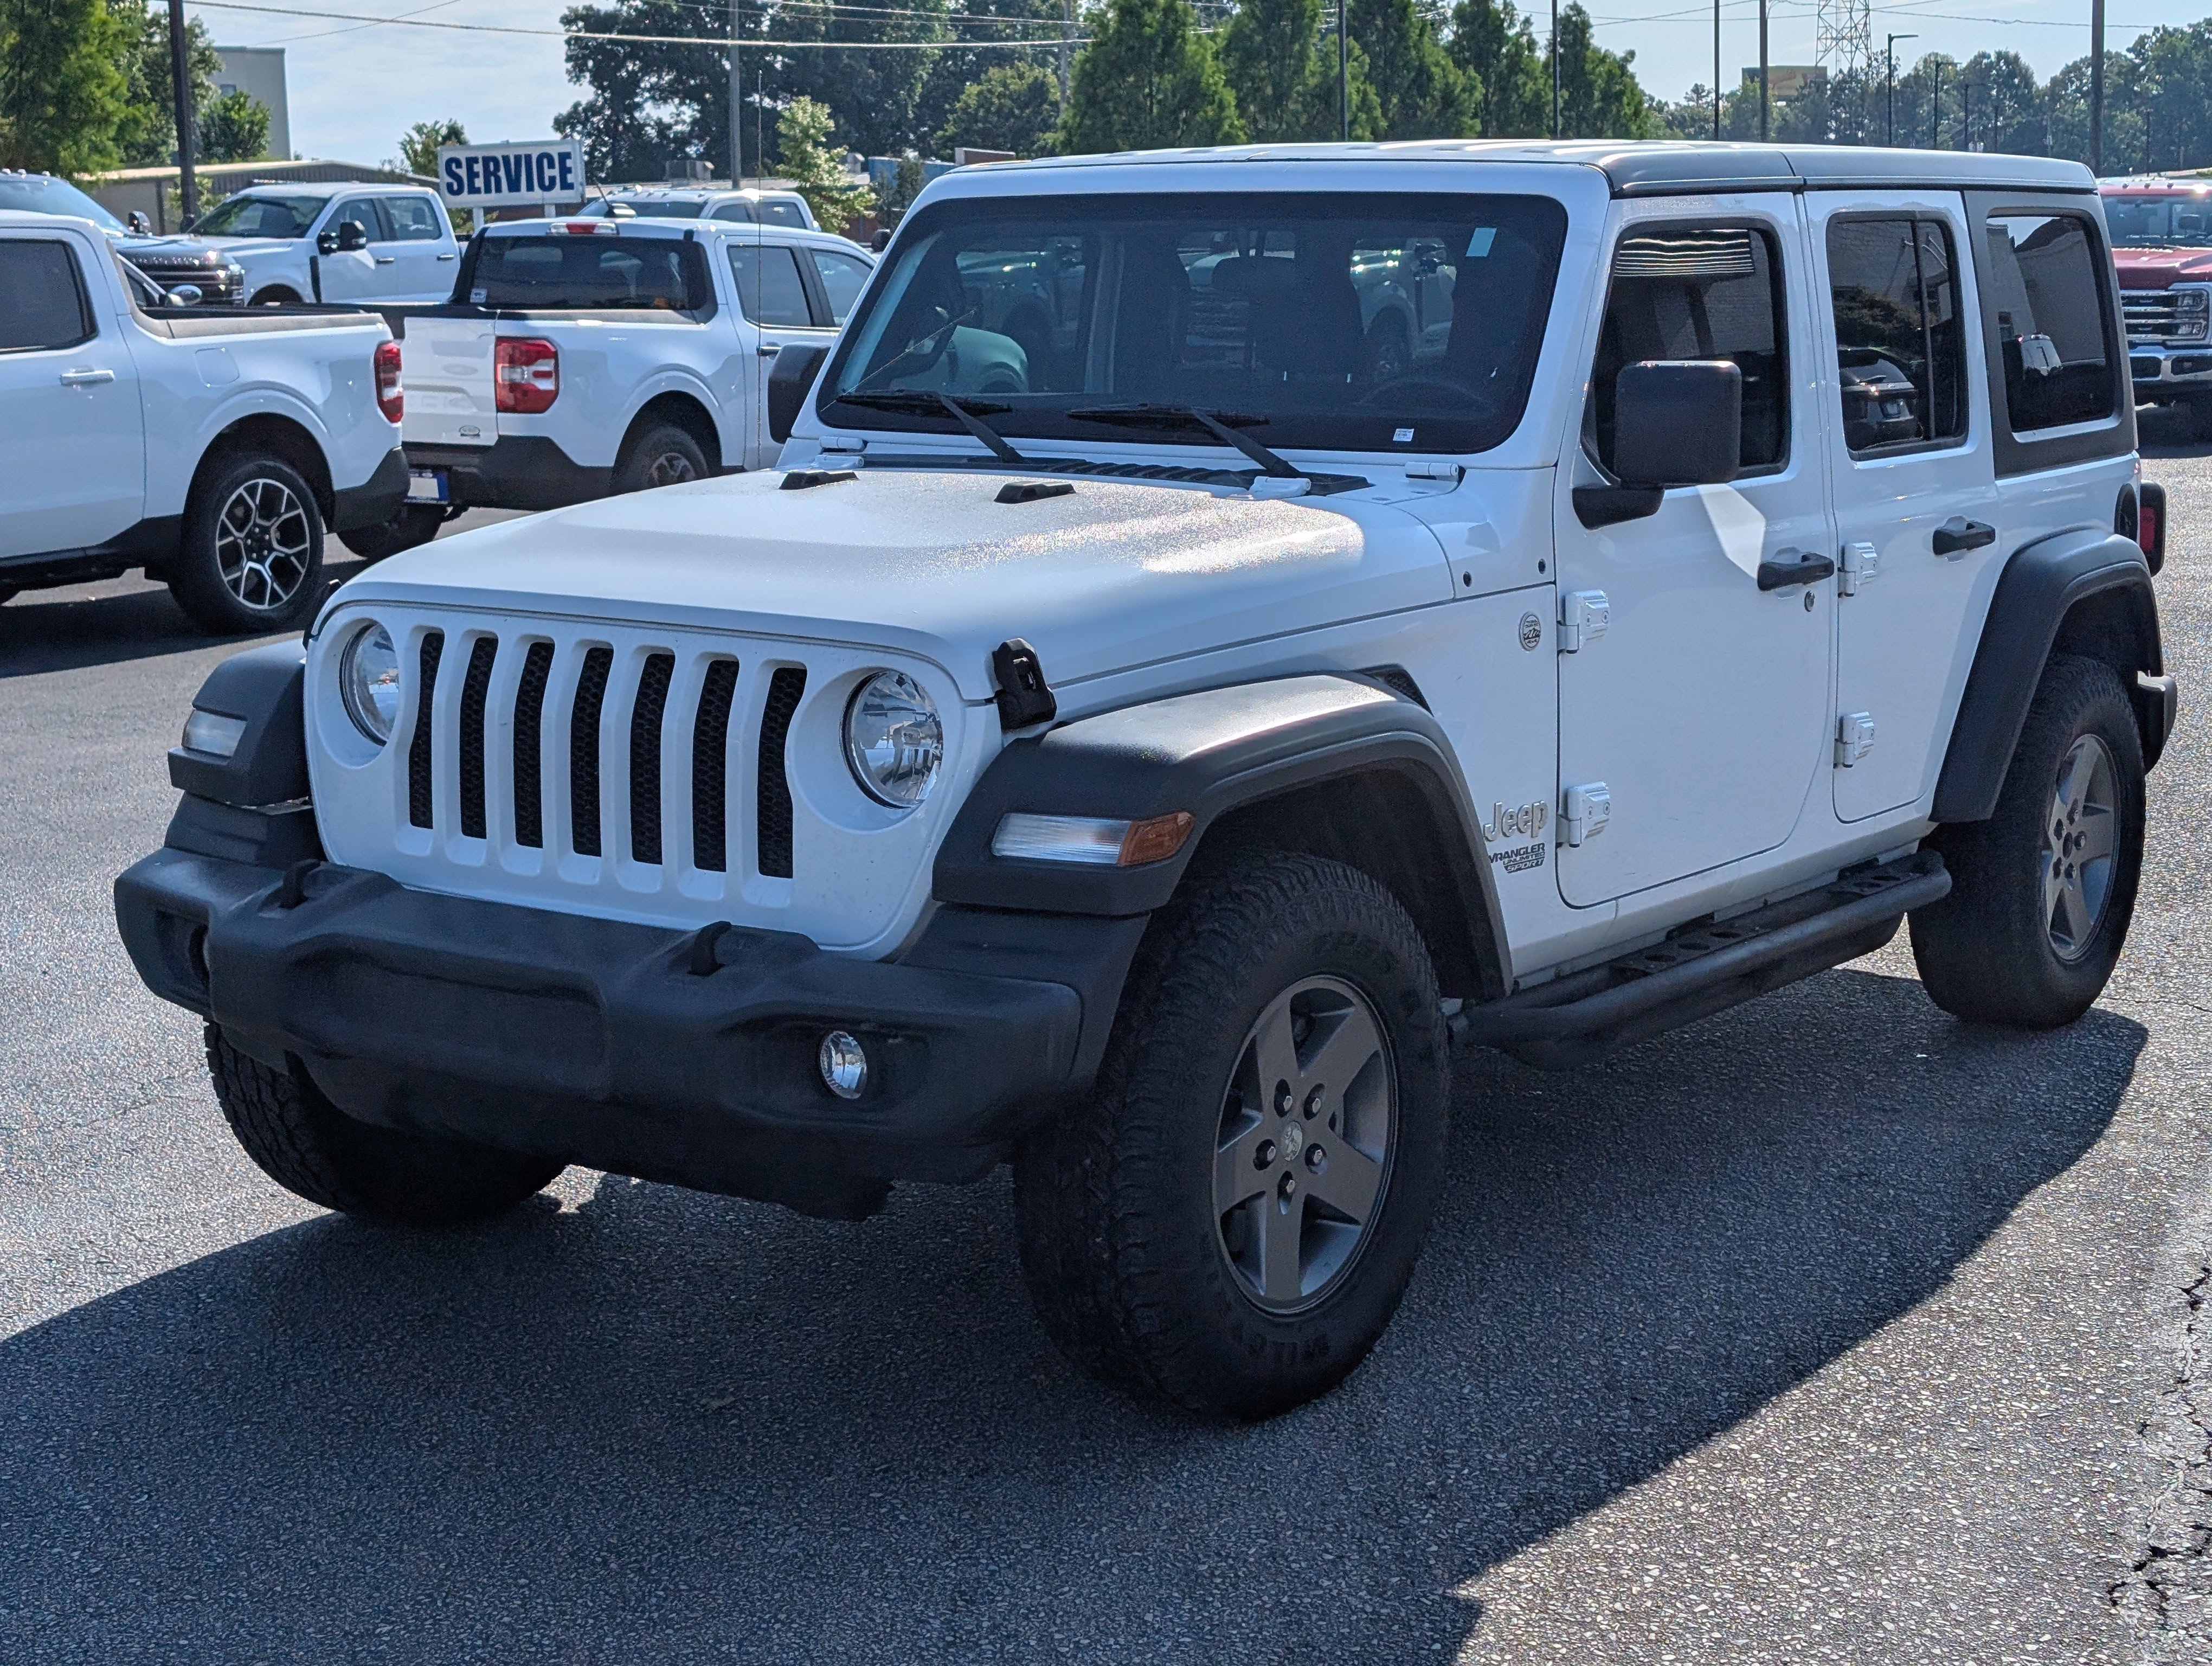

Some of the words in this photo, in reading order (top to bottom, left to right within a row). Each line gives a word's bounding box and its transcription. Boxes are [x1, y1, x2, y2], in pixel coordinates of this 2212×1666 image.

[445, 152, 575, 196] SERVICE
[1483, 800, 1548, 842] Jeep
[1502, 851, 1545, 865] UNLIMITED
[1504, 857, 1544, 872] SPORT
